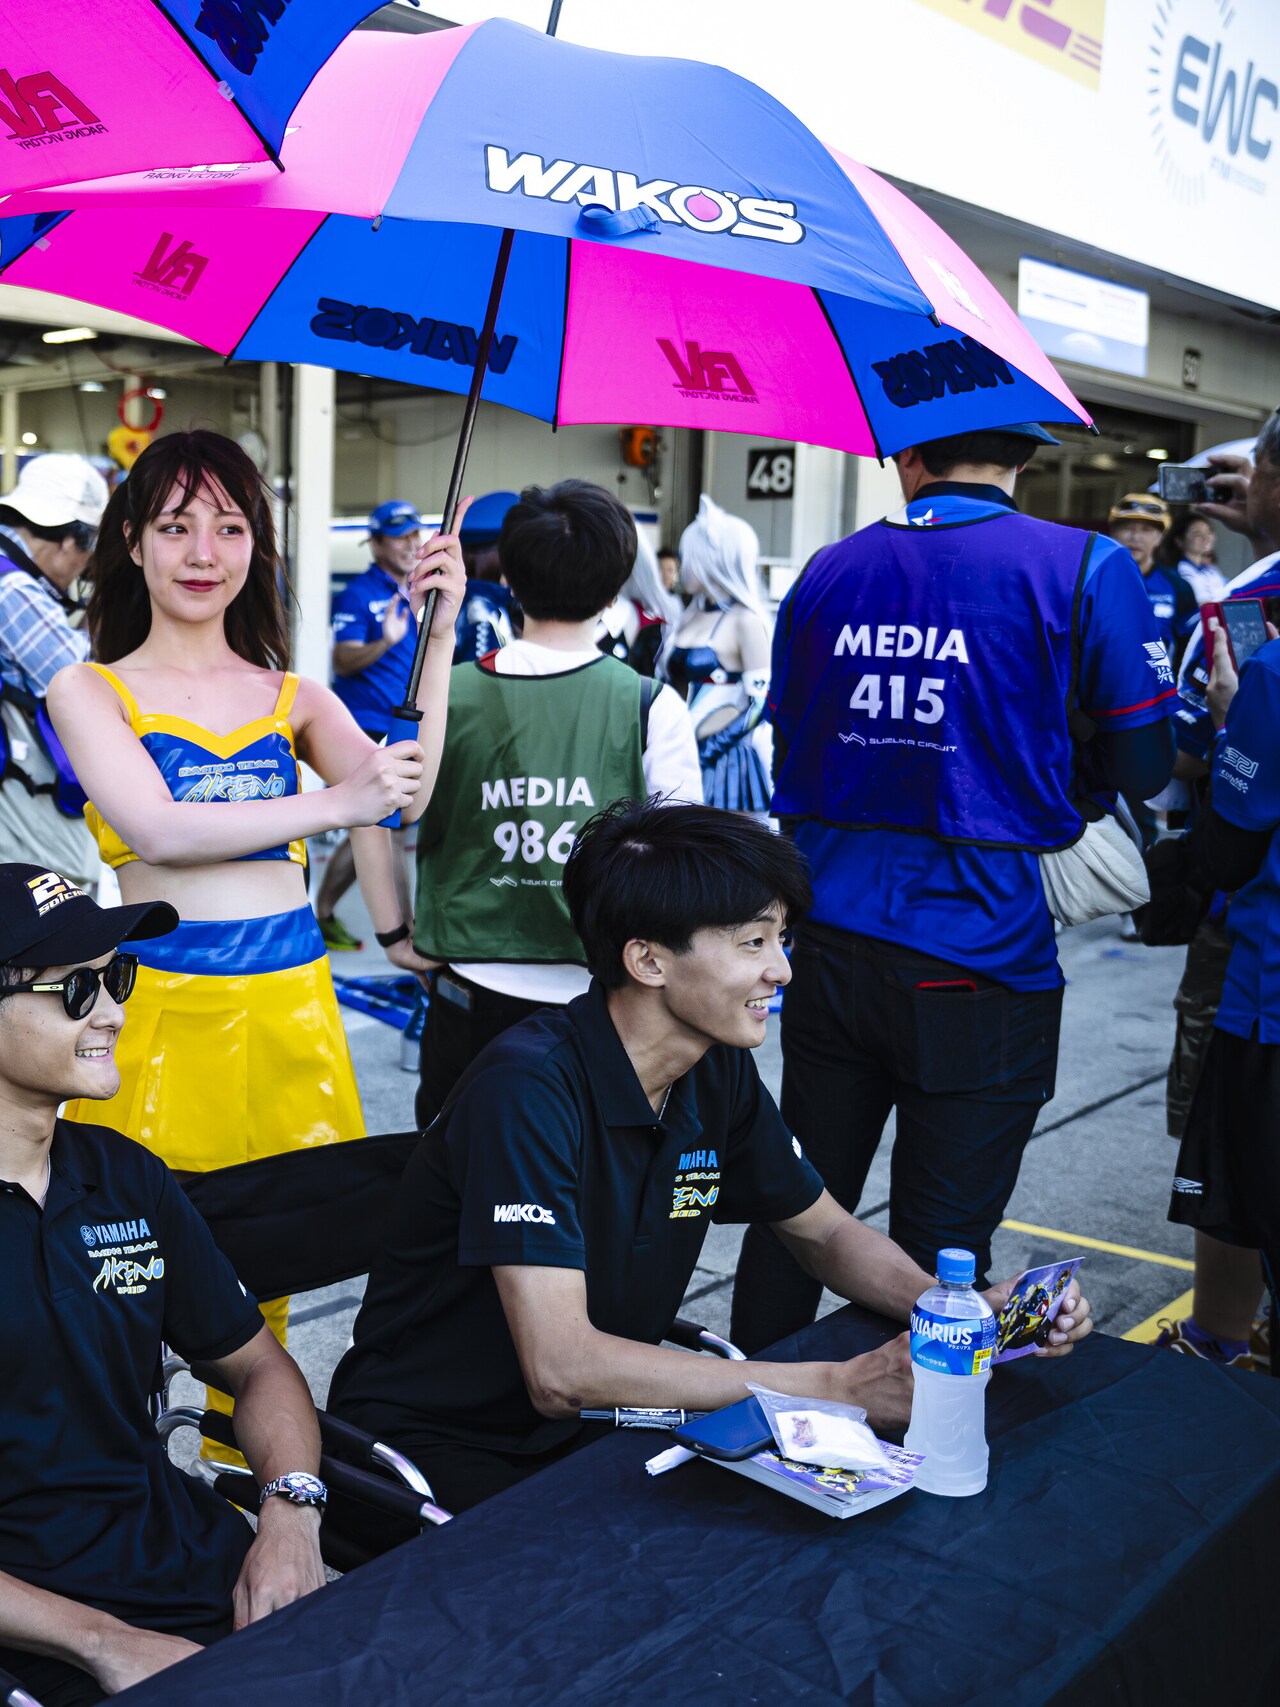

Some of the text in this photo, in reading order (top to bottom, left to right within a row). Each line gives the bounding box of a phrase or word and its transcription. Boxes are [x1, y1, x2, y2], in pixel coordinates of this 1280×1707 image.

[1173, 35, 1279, 161] EWC
[484, 143, 806, 245] WAKO'S
[748, 455, 792, 493] 48
[833, 624, 969, 664] MEDIA
[849, 674, 945, 724] 415
[869, 737, 916, 746] SUZUKA
[178, 759, 279, 777] RACING TEAM
[481, 776, 595, 810] MEDIA
[493, 820, 577, 864] 986
[673, 1185, 720, 1210] ENO
[93, 1218, 151, 1244] YAMAHA
[123, 1240, 158, 1254] TEAM
[92, 1255, 165, 1294] AKENO
[910, 1312, 973, 1345] QUARIUS
